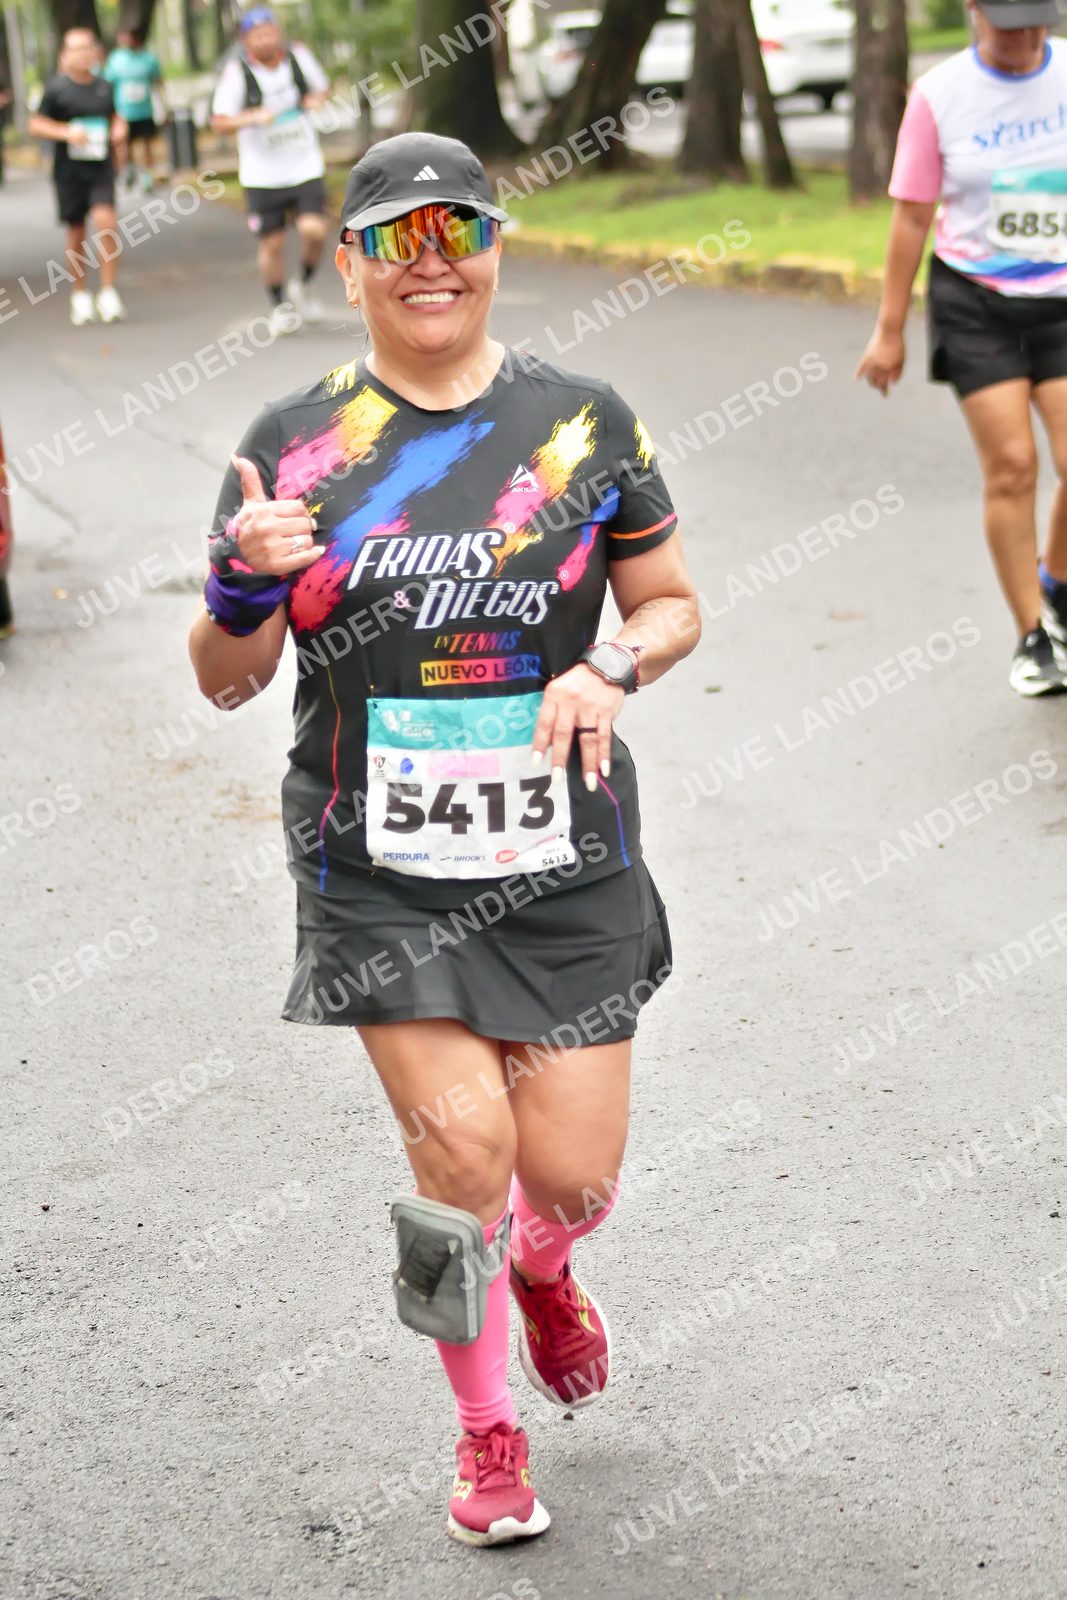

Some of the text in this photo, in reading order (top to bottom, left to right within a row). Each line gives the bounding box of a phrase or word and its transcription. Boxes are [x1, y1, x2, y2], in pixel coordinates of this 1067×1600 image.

[347, 531, 502, 590] FRIDAS
[414, 580, 559, 630] DIEGOS
[449, 631, 522, 653] TENNIS
[424, 655, 538, 682] NUEVO LEÓN
[382, 775, 554, 834] 5413
[383, 852, 430, 861] PERDURA
[542, 853, 568, 867] 5413
